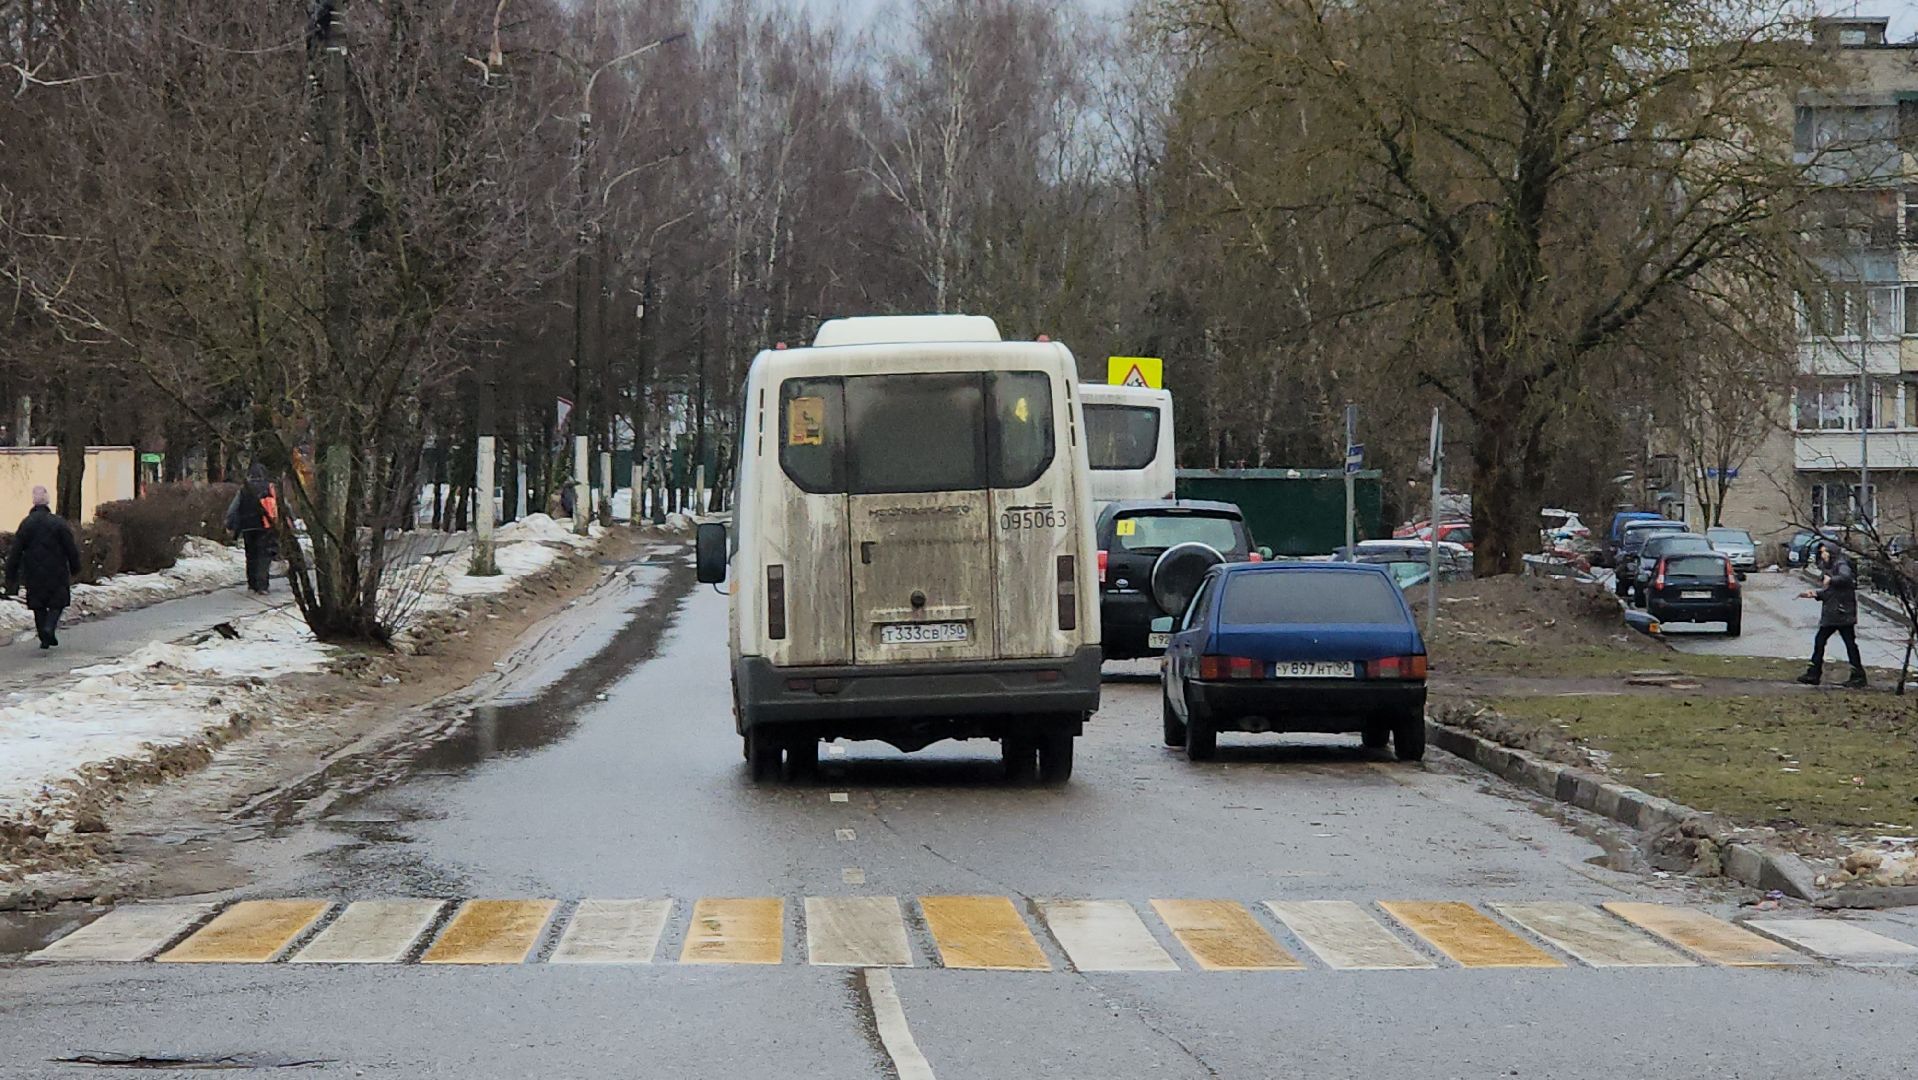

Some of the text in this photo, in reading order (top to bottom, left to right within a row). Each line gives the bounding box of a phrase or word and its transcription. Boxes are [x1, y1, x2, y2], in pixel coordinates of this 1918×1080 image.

[1000, 510, 1067, 530] 095063
[886, 624, 965, 641] Т333СВ 750
